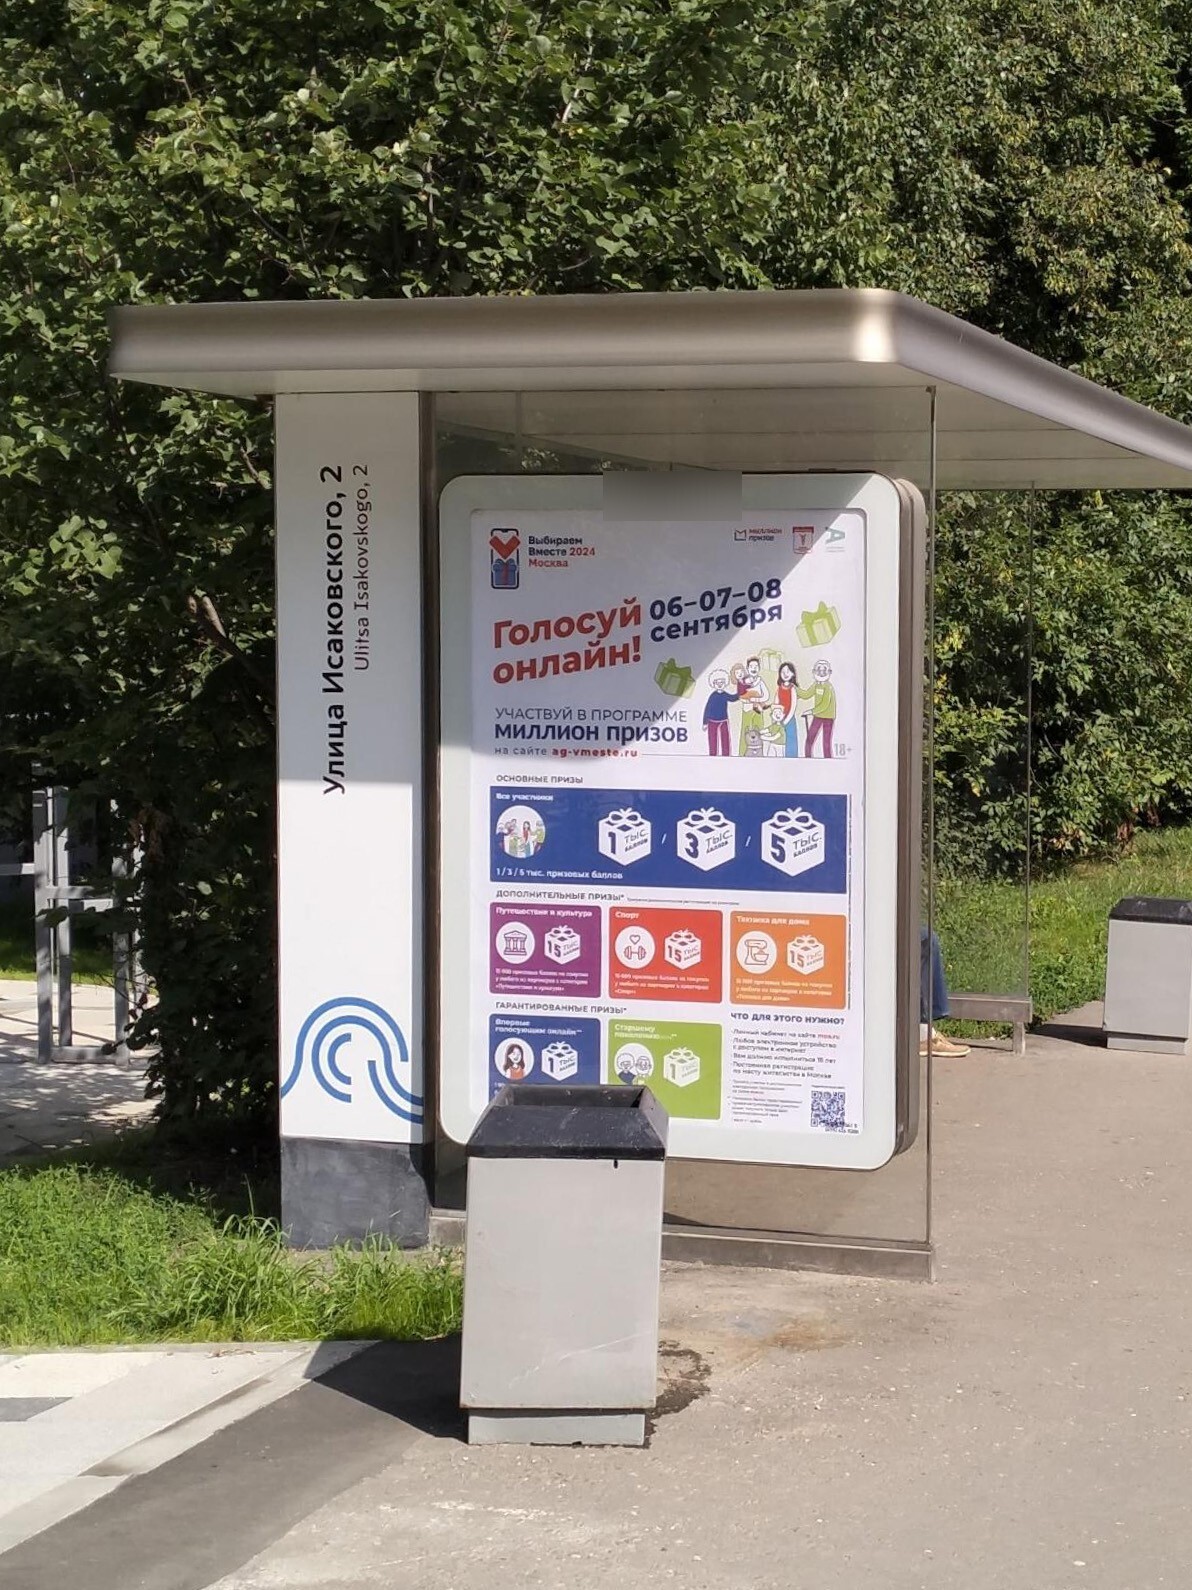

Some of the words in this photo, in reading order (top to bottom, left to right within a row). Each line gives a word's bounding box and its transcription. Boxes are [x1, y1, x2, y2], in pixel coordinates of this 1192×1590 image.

[320, 465, 342, 483] 2
[353, 464, 368, 476] 2
[352, 483, 372, 611] Isakovskogo,
[528, 535, 583, 546] Выбираем
[528, 547, 567, 556] Вместе
[569, 547, 596, 556] 2024
[528, 559, 568, 568] Москва
[321, 492, 348, 693] Исаковского,
[493, 596, 641, 648] Голосуй
[650, 603, 783, 642] сентября
[354, 617, 371, 671] Ulitsa
[493, 635, 641, 684] онлайн!
[495, 706, 572, 720] УЧАСТВУЙ
[578, 710, 586, 721] В
[592, 710, 687, 722] ПРОГРАММЕ
[322, 704, 348, 795] Улица
[495, 747, 508, 755] на
[513, 746, 547, 756] сайте
[551, 747, 639, 758] ag-vmeste.ru
[834, 743, 852, 757] 18+
[496, 774, 549, 783] ОСНОВНЫЕ
[551, 775, 583, 784] ПРИЗЫ
[608, 831, 616, 854] 1
[685, 832, 699, 858] 3
[770, 832, 786, 863] 5
[496, 890, 585, 900] ДОПОЛНИТЕЛЬНЫЕ
[615, 911, 640, 920] Спорт
[547, 940, 562, 958] 15
[667, 945, 682, 963] 15
[790, 950, 805, 968] 15
[495, 1002, 588, 1013] ГАРАНТИРОВАННЫЕ
[731, 1012, 749, 1020] ЧТО
[752, 1013, 771, 1021] ДЛЯ
[773, 1014, 803, 1023] ЭТОГО
[805, 1016, 845, 1025] НУЖНО?
[548, 1056, 554, 1073] 1
